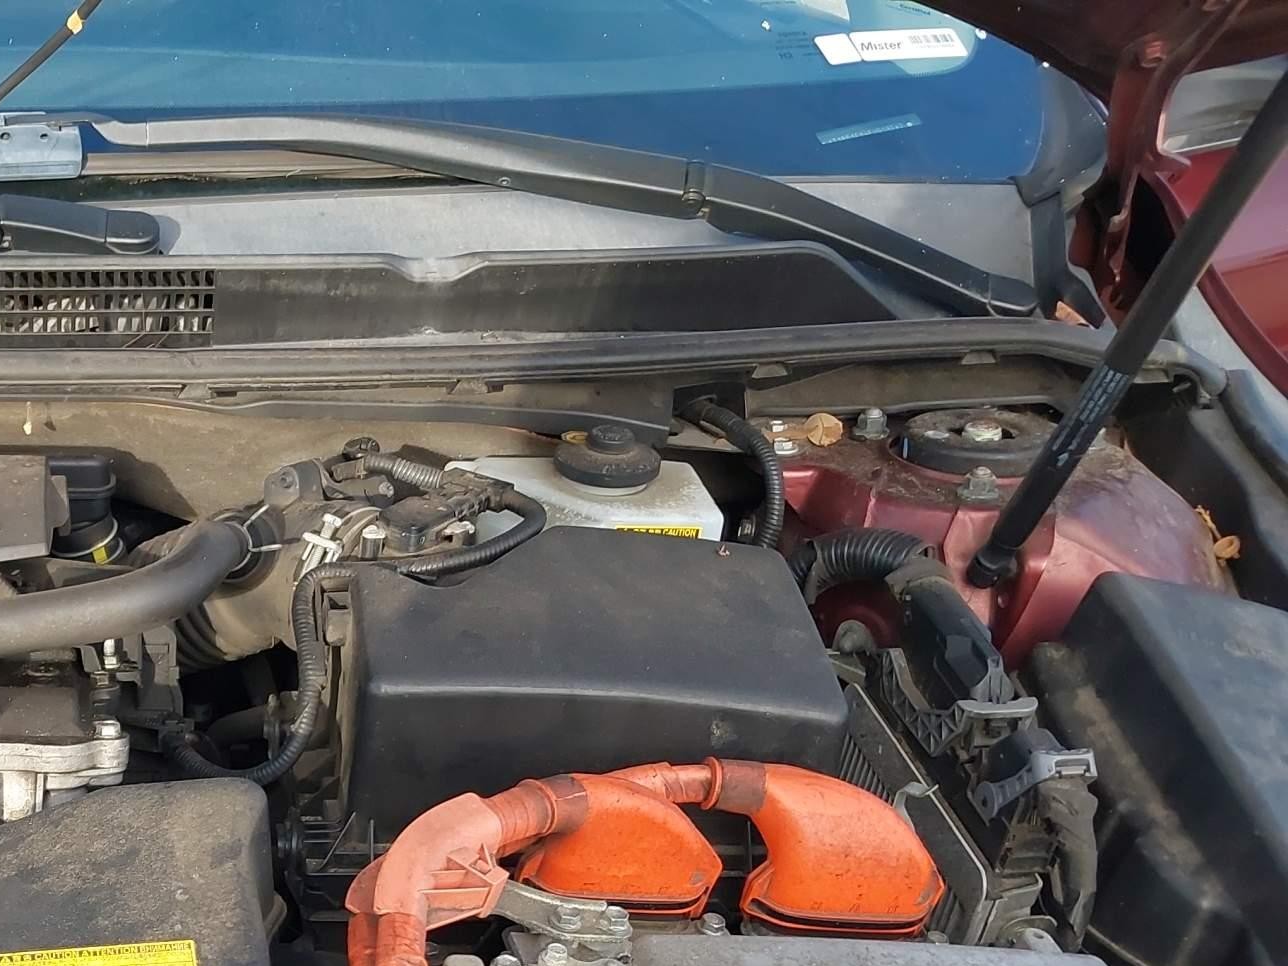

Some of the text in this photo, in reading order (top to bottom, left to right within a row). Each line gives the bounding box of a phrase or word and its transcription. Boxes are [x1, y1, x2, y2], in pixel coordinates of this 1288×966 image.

[860, 41, 902, 51] Mister
[662, 528, 697, 538] CAUTION
[34, 950, 79, 961] CAUTION
[81, 945, 136, 958] ATTENTION
